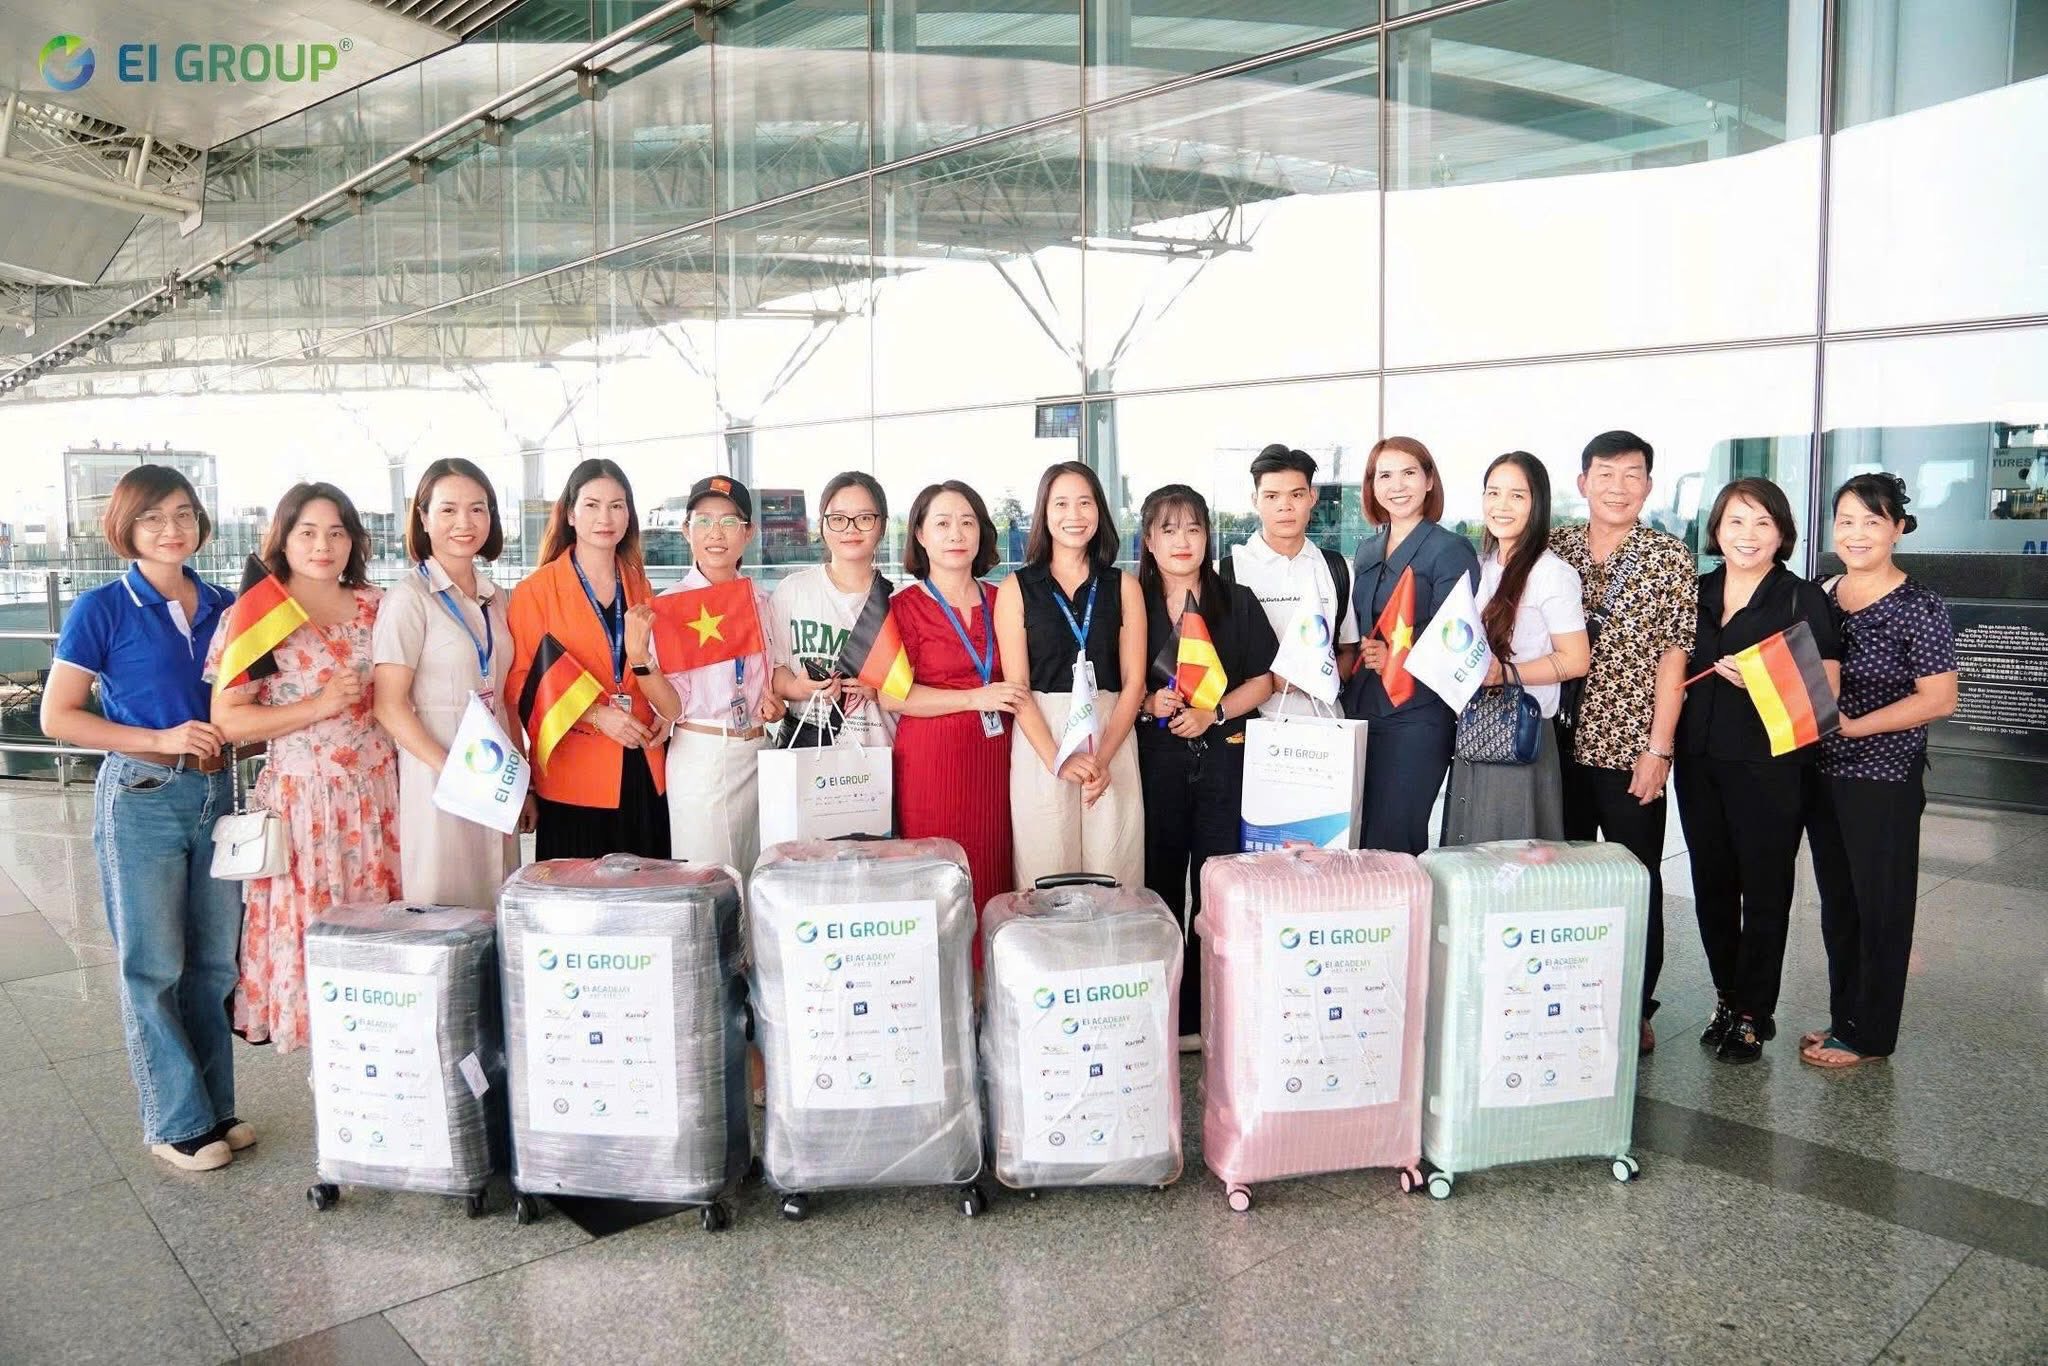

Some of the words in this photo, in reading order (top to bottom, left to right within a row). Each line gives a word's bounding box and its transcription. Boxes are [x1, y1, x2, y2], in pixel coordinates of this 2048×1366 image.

[1321, 661, 1334, 676] EI
[830, 776, 838, 786] EI
[495, 788, 510, 804] EI
[827, 923, 843, 939] EI
[850, 920, 916, 937] GROUP
[1309, 931, 1324, 945] EI
[1331, 928, 1391, 943] GROUP
[1531, 929, 1544, 943] EI
[1551, 926, 1608, 943] GROUP
[566, 954, 581, 968] EI
[588, 954, 651, 969] GROUP
[856, 952, 896, 961] ACADEMY
[345, 987, 357, 1002] EI
[363, 988, 417, 1007] GROUP
[1064, 989, 1080, 1004] EI
[1087, 981, 1149, 1002] GROUP
[1092, 1015, 1130, 1024] ACADEMY
